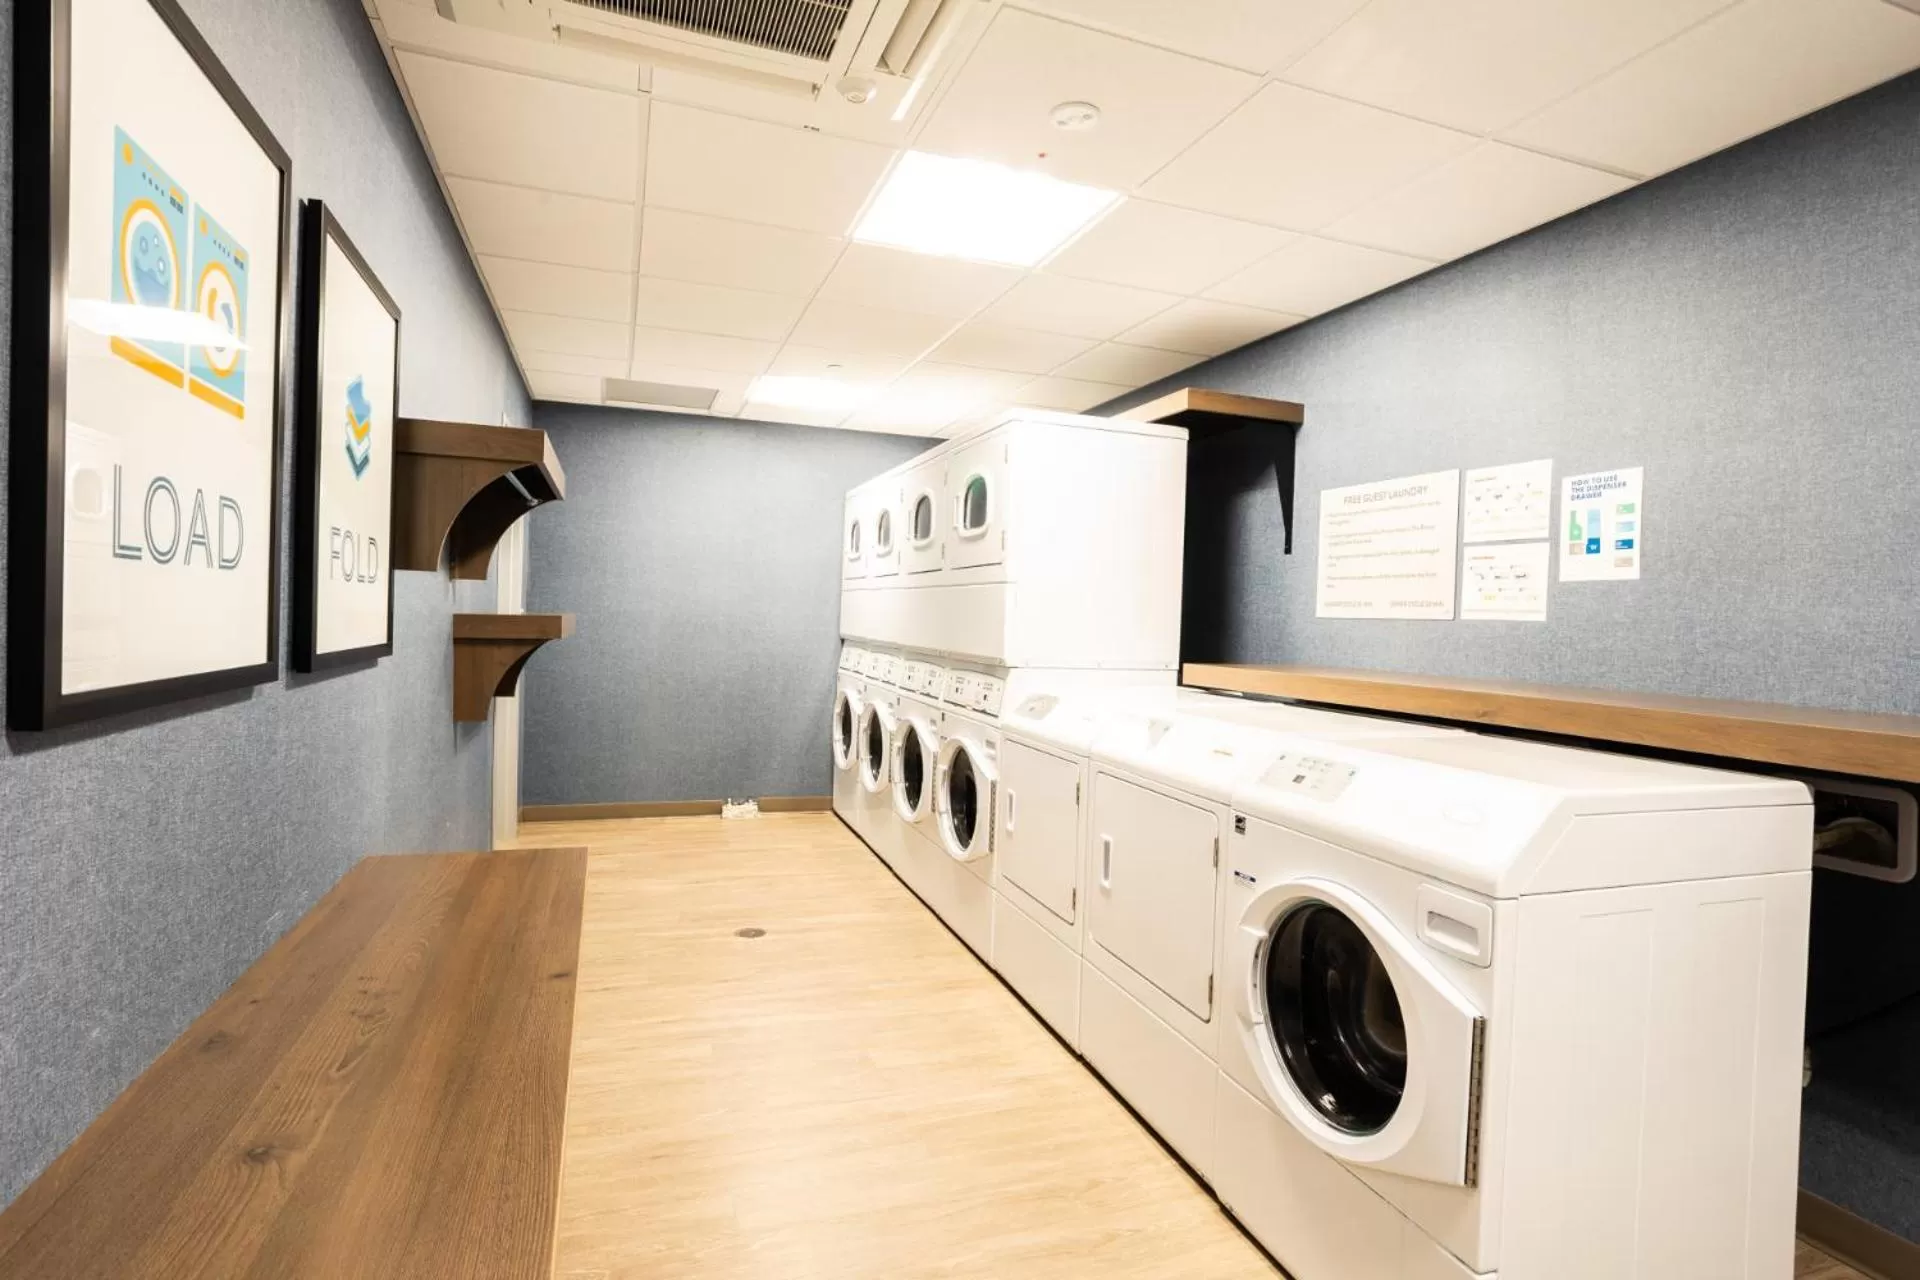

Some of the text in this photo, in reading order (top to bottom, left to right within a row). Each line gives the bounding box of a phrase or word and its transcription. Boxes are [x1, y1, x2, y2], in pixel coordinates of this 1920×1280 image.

[1603, 474, 1618, 482] USE
[1586, 481, 1627, 492] DISPENSER
[1343, 485, 1429, 505] FREE GUEST LAUNDRY
[1571, 491, 1602, 501] DRAWER
[113, 464, 243, 570] LOAD
[330, 526, 379, 584] FOLD
